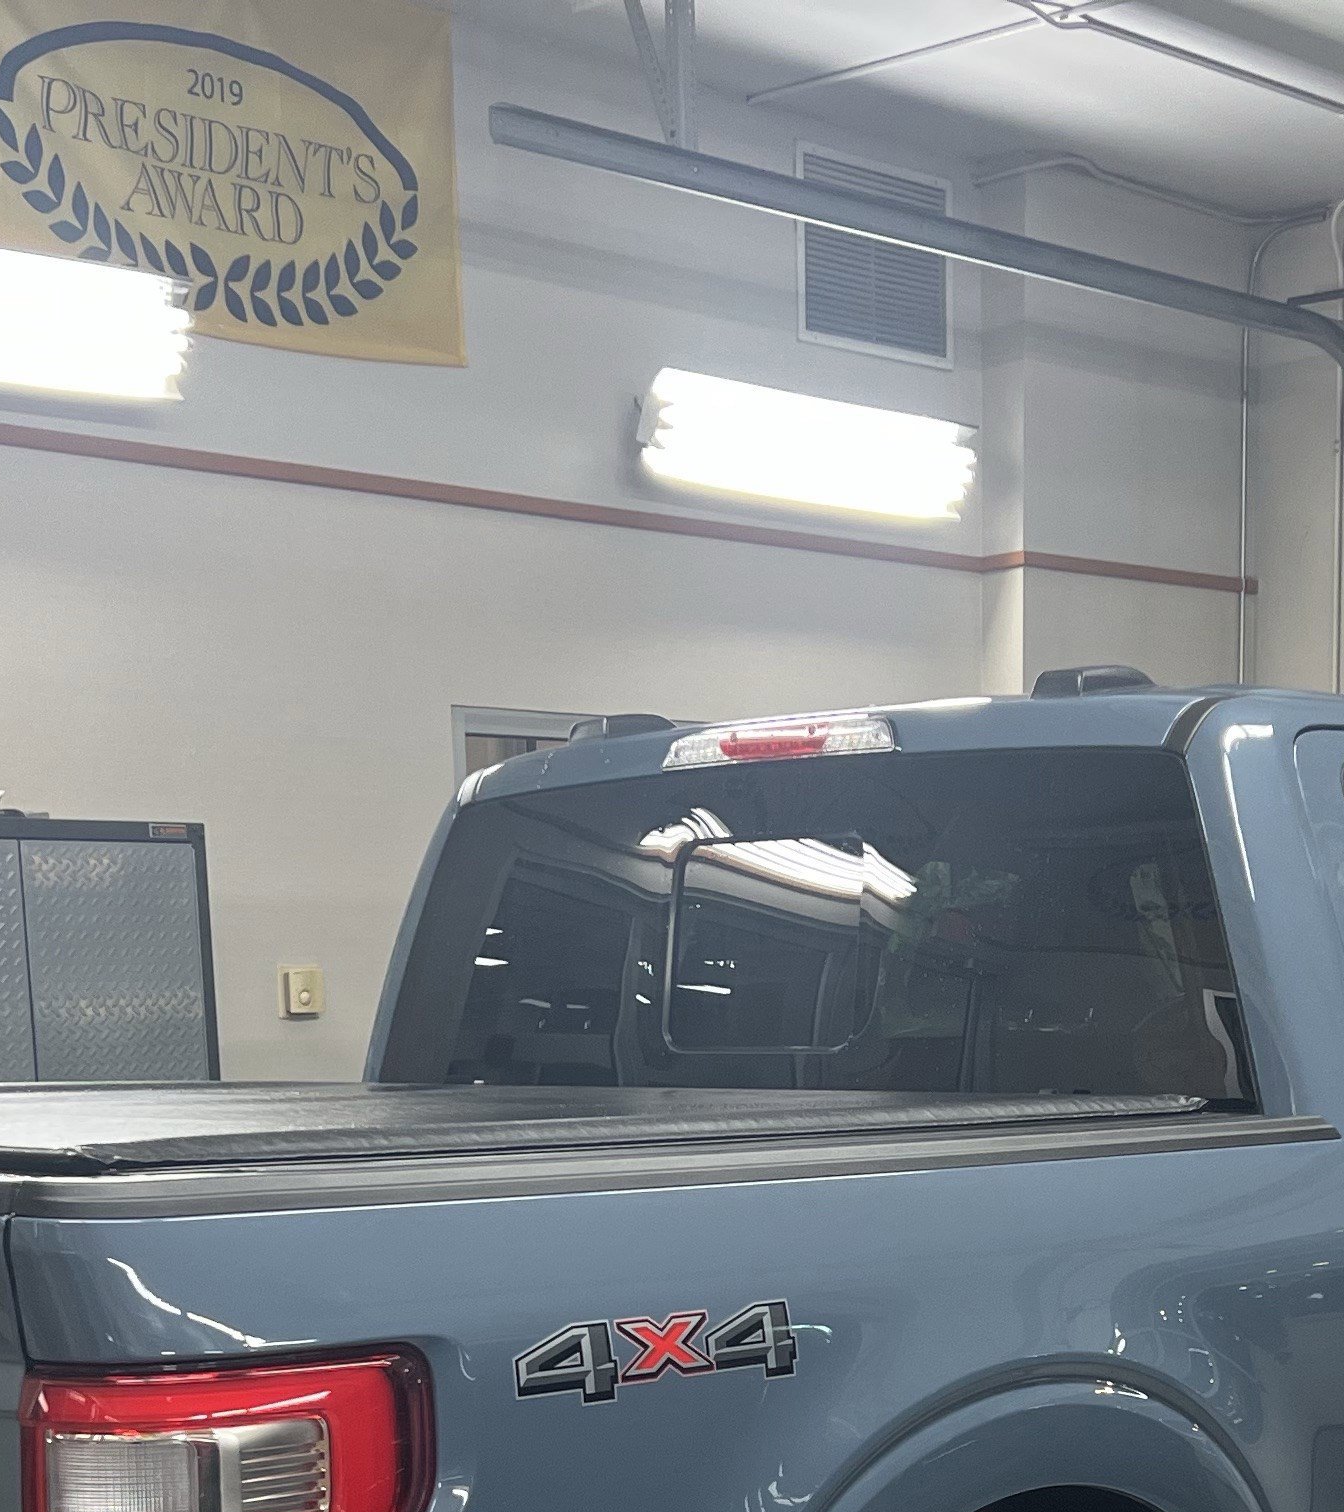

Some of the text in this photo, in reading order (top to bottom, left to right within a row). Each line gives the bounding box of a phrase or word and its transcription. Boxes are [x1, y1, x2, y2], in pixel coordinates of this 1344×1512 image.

[187, 69, 243, 106] 2019
[37, 75, 381, 204] PRESIDENT'S
[121, 161, 304, 245] AWARD
